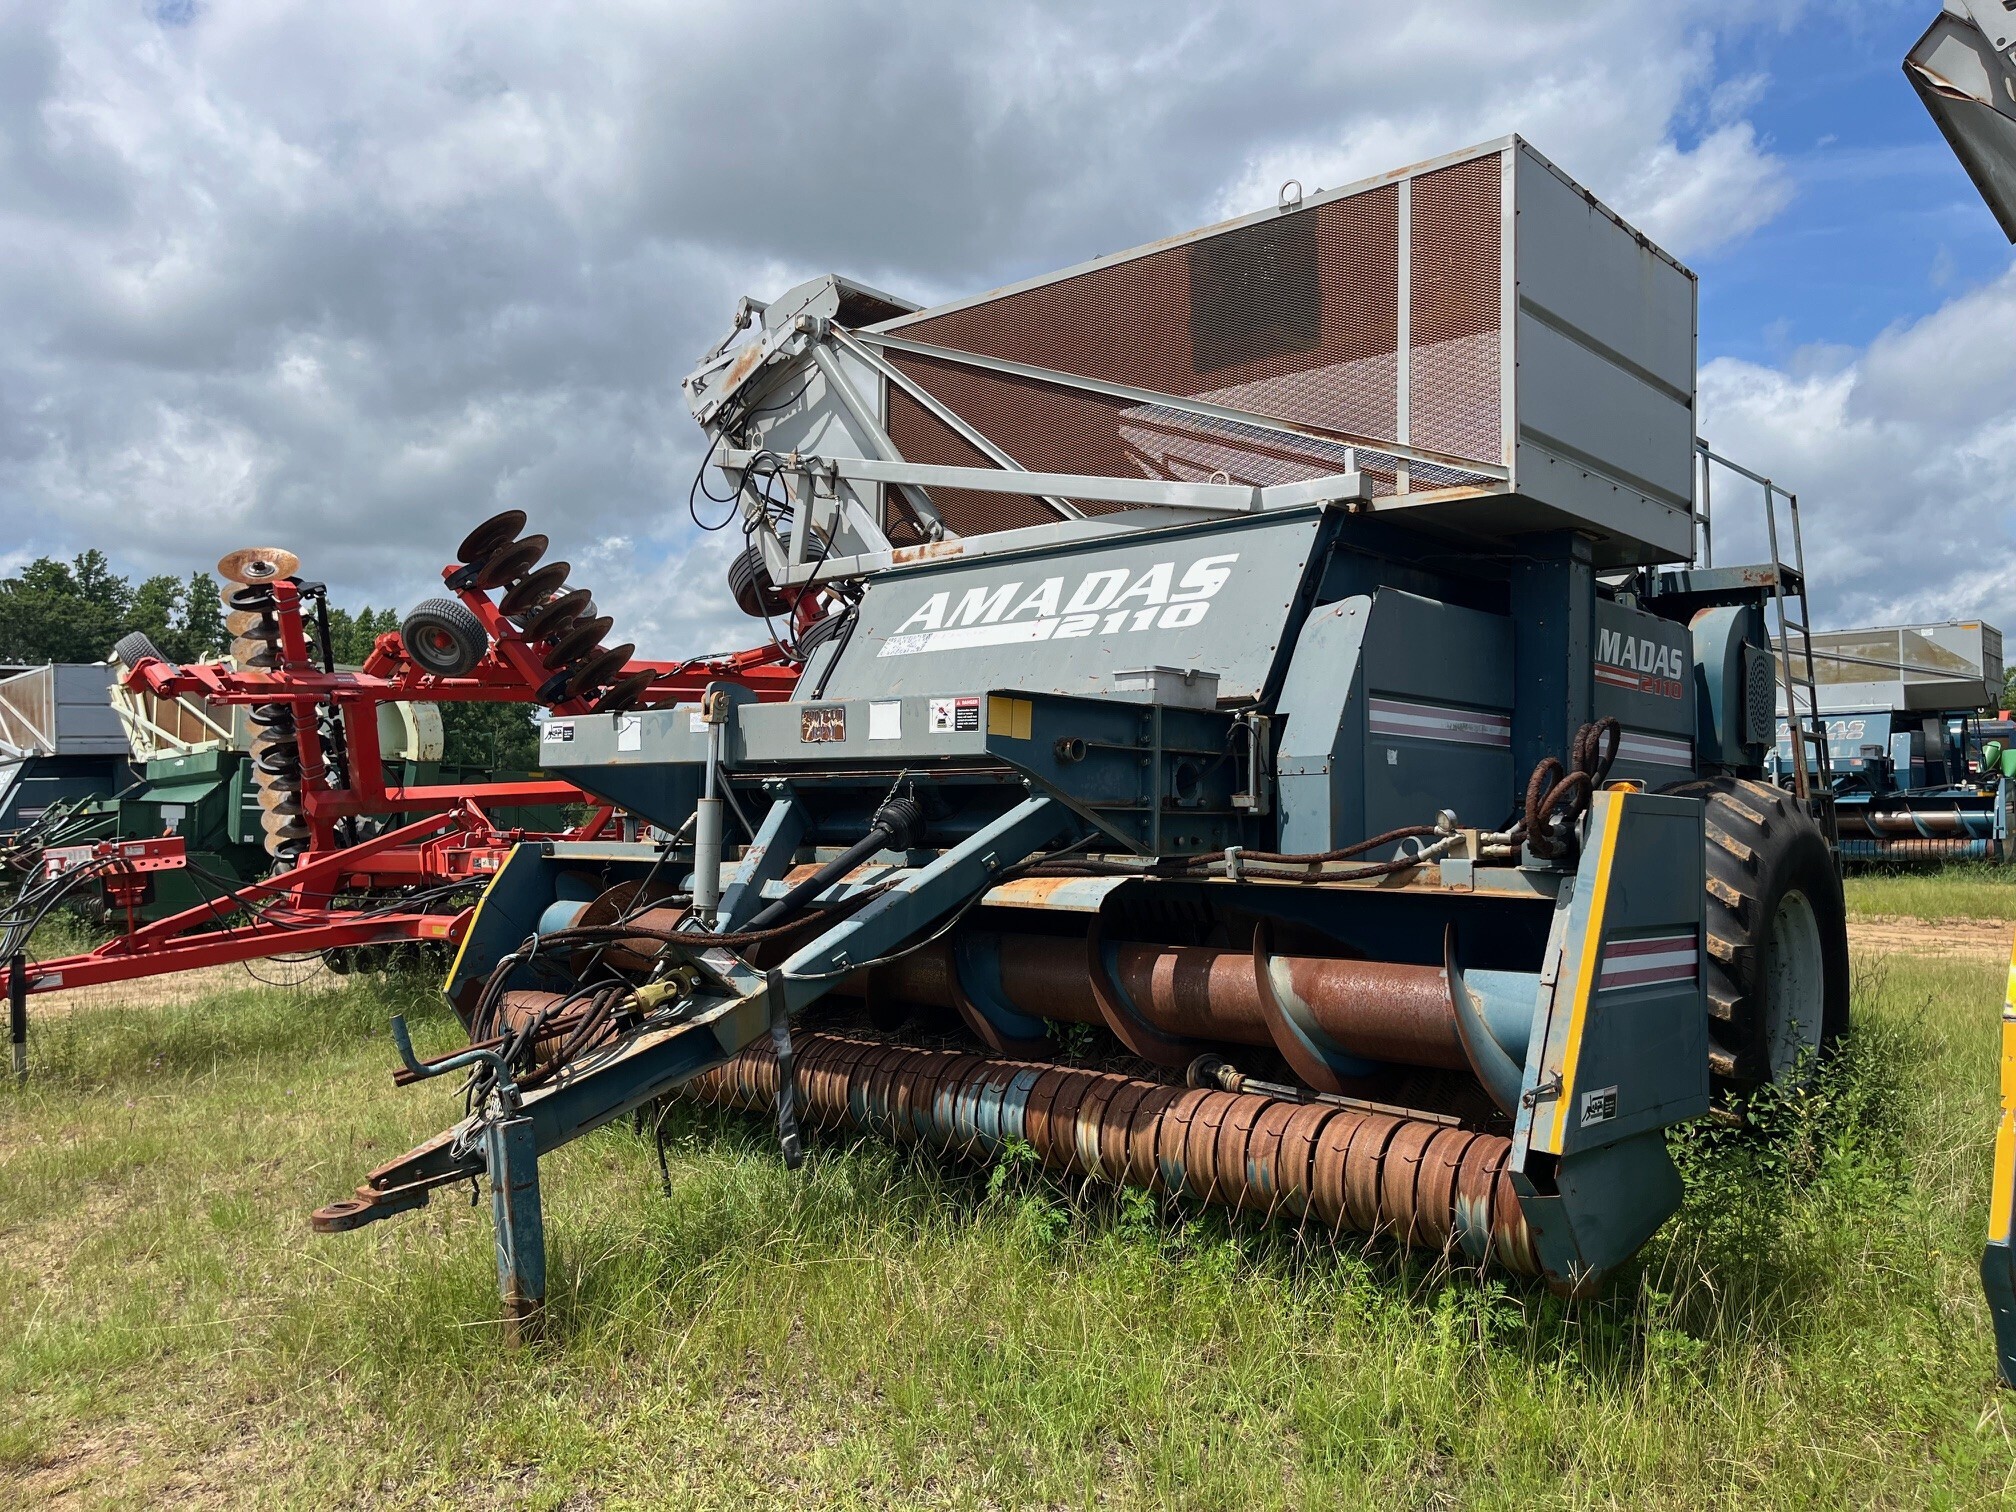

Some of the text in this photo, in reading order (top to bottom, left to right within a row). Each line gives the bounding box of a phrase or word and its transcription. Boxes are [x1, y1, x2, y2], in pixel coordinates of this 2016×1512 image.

[893, 553, 1240, 634] AMADAS
[1051, 602, 1210, 639] 2110
[1594, 627, 1683, 680] MADAS
[1640, 674, 1683, 700] 2110
